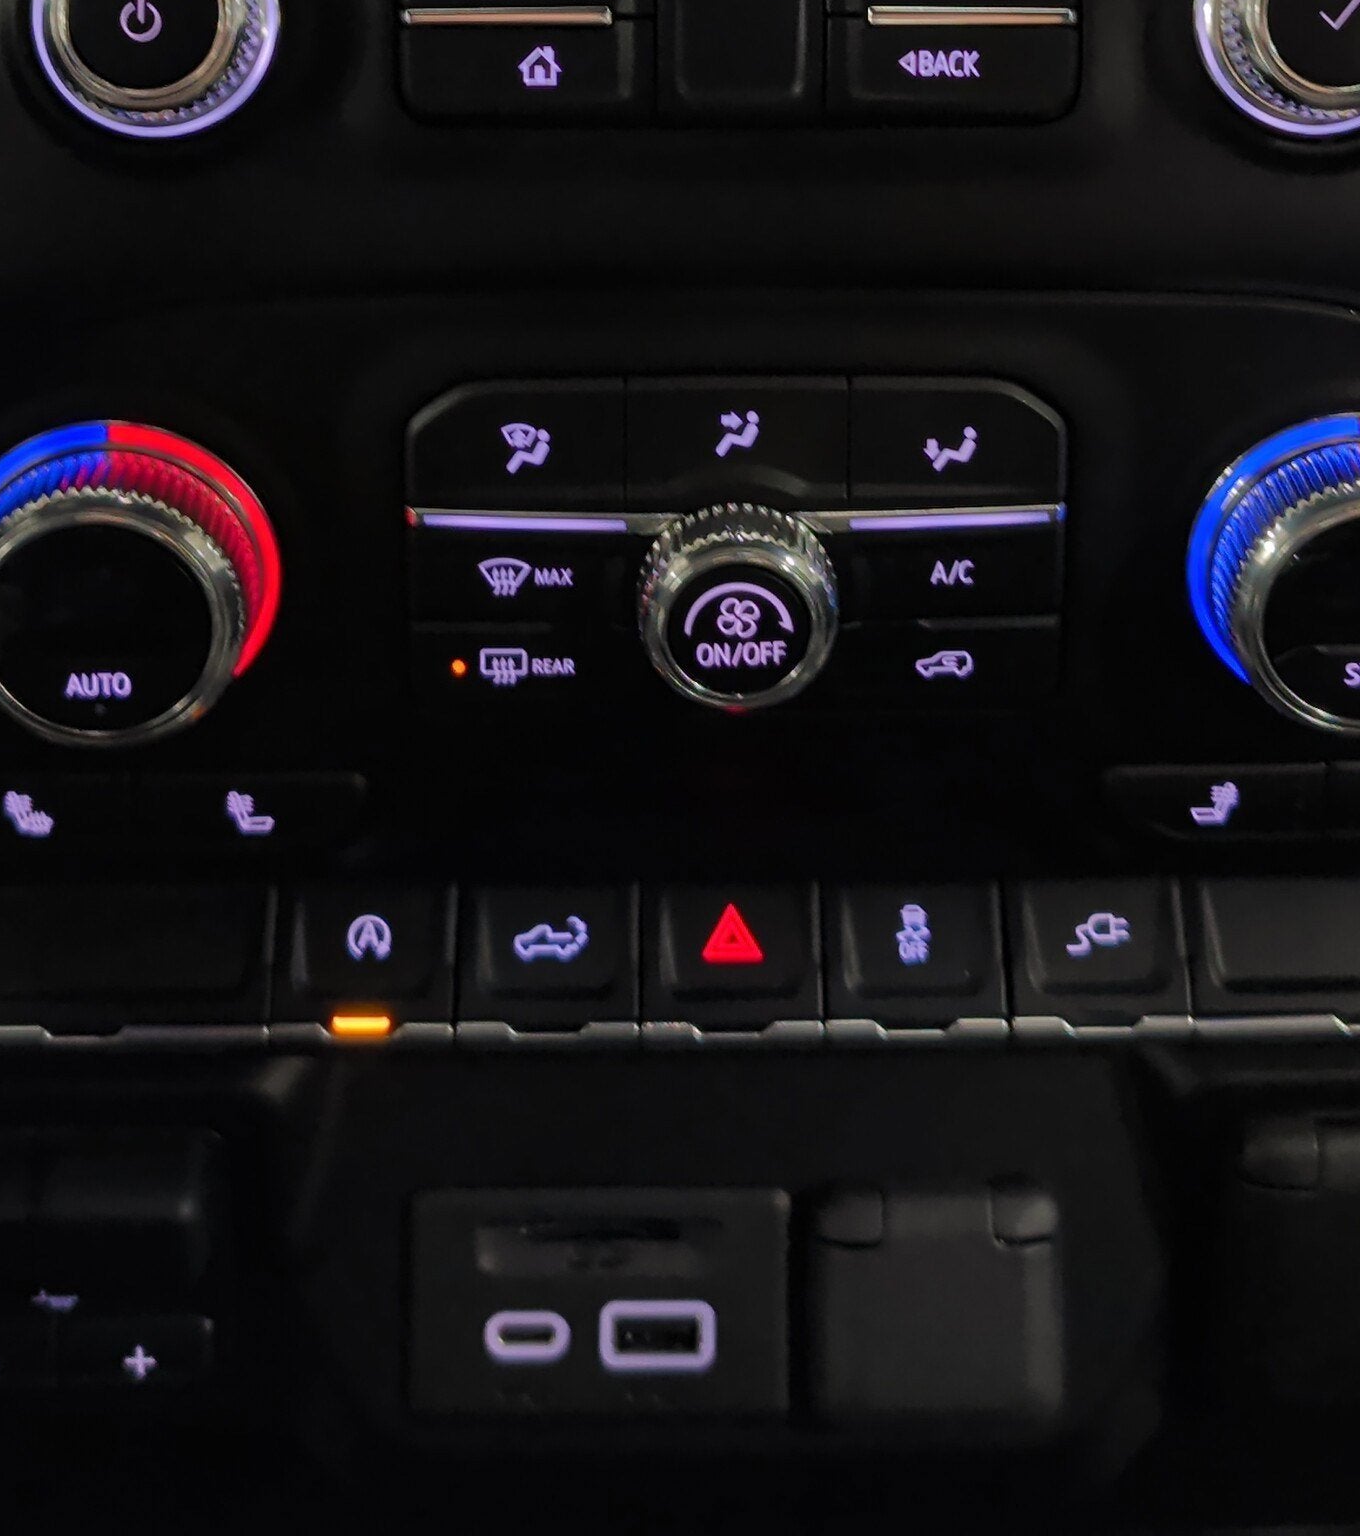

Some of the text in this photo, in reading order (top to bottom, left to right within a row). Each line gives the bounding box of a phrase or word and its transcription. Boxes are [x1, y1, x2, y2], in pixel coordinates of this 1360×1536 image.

[918, 49, 981, 79] BACK
[533, 566, 574, 588] MAX
[929, 558, 975, 587] A/C
[531, 656, 576, 677] REAR
[696, 639, 788, 668] ON/OFF
[65, 671, 132, 699] AUTO
